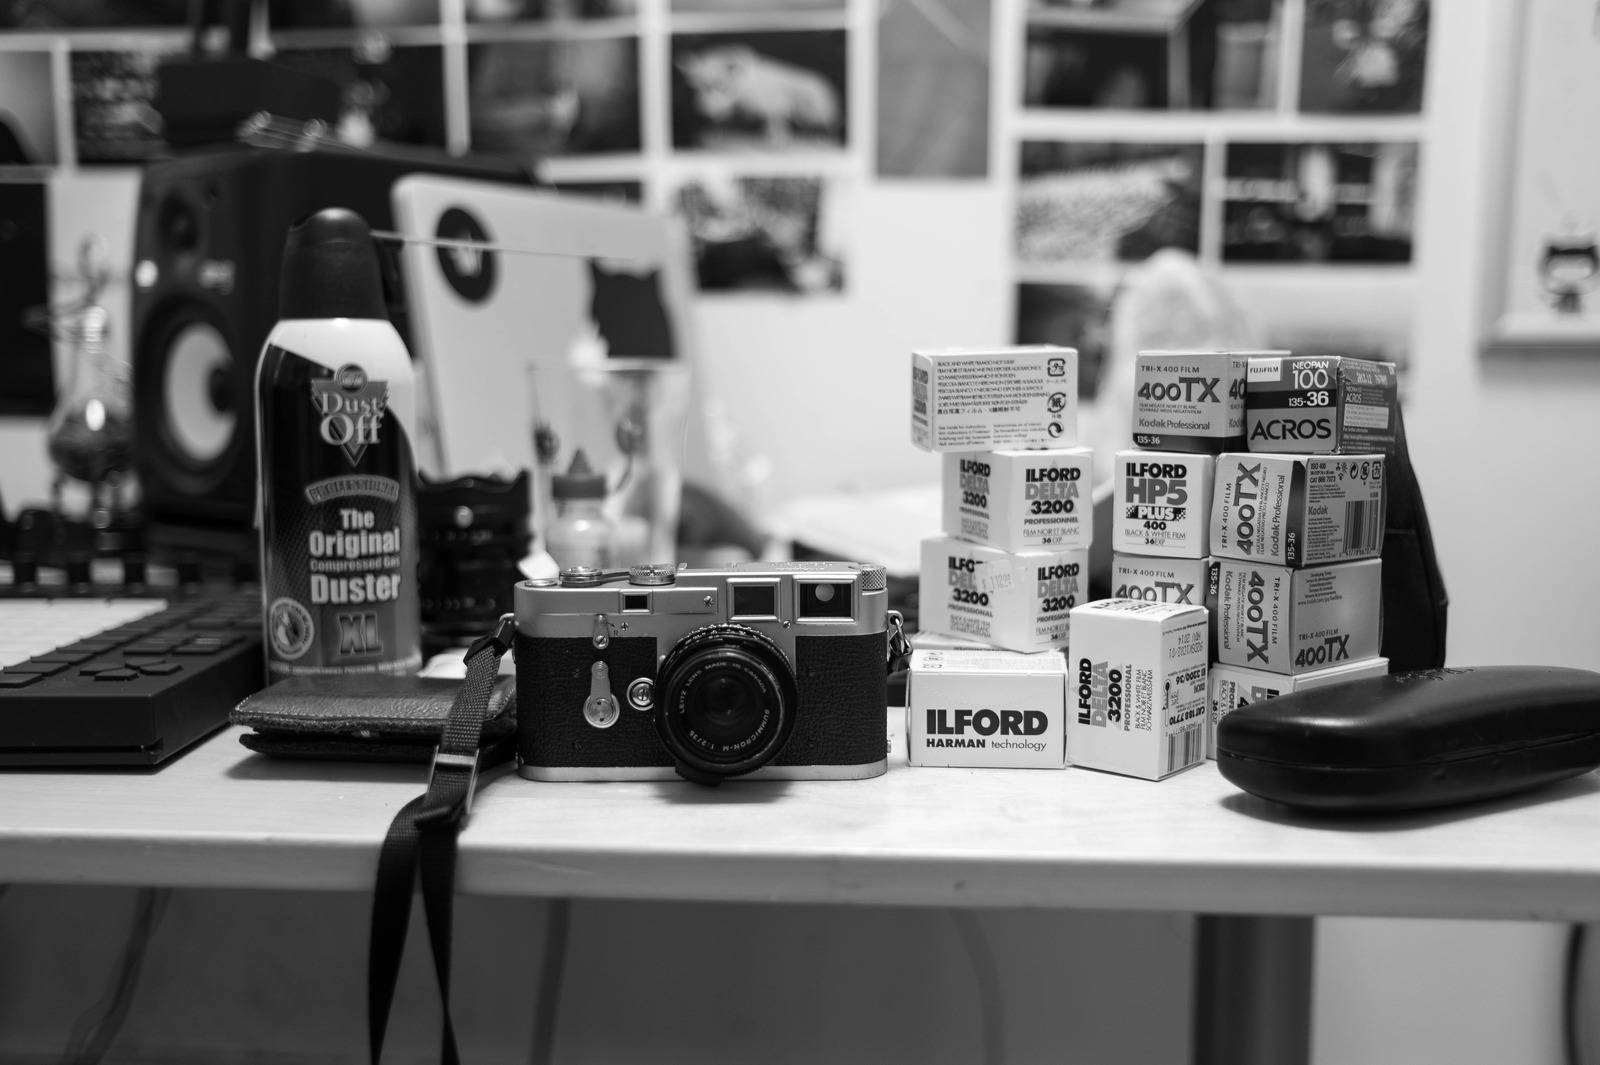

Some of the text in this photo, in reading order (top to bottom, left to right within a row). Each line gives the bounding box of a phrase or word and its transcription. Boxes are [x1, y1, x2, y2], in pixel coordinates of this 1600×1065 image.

[1292, 361, 1329, 370] NEOPAN
[1292, 369, 1328, 389] 100
[1138, 376, 1221, 403] 400TX
[1288, 391, 1329, 406] 135-36
[1345, 393, 1361, 403] ACROS
[321, 391, 379, 416] Dust
[321, 413, 384, 446] Off
[1139, 418, 1210, 430] Kodak Professional
[1250, 418, 1332, 440] ACROS
[1137, 436, 1160, 444] 135-36
[960, 459, 990, 477] ILFORD
[1026, 468, 1081, 482] ILFORD
[1126, 462, 1187, 478] ILFORD
[962, 491, 987, 508] 3200
[1025, 482, 1079, 500] DELTA
[1126, 478, 1188, 506] HP5
[1031, 500, 1074, 514] 3200
[1138, 506, 1174, 520] PLUS
[1232, 462, 1261, 556] 400TX
[1270, 474, 1285, 556] Kodak Professional
[1308, 505, 1328, 515] Kodak
[340, 508, 375, 530] The
[1024, 517, 1079, 525] PROFESSIONNEL
[1143, 521, 1167, 530] 400
[310, 528, 400, 558] Original
[1150, 530, 1171, 538] WHITE
[310, 558, 382, 572] Compressed
[949, 556, 983, 573] ILFO
[1038, 563, 1079, 581] ILFORD
[1140, 568, 1154, 576] 400
[310, 572, 400, 605] Duster
[948, 572, 977, 590] DEL
[1038, 578, 1078, 598] DELTA
[1224, 571, 1233, 602] Kodak
[953, 588, 989, 606] 3200
[1115, 582, 1194, 605] 400TX
[948, 603, 993, 618] PROFESSIONAL
[1042, 594, 1074, 612] 3200
[1037, 613, 1070, 623] PROFESSION
[1246, 571, 1269, 664] 400TX
[338, 610, 384, 656] XL
[1298, 632, 1314, 640] TRI-X
[1326, 628, 1338, 636] FILM
[1295, 634, 1350, 667] 400TX
[686, 670, 702, 686] LENS
[705, 661, 728, 670] MADE
[744, 667, 767, 693] CANADA
[1176, 670, 1200, 685] 3200/36
[1078, 658, 1092, 726] ILFORD
[1091, 661, 1108, 728] DELTA
[1108, 669, 1122, 722] 3200
[1212, 700, 1218, 712] 36
[927, 709, 1048, 736] ILFORD
[1169, 706, 1205, 726] CAT 188 7710
[689, 708, 770, 751] SUMMICRON-M 1:2/35
[926, 739, 1046, 752] HARMAN technology
